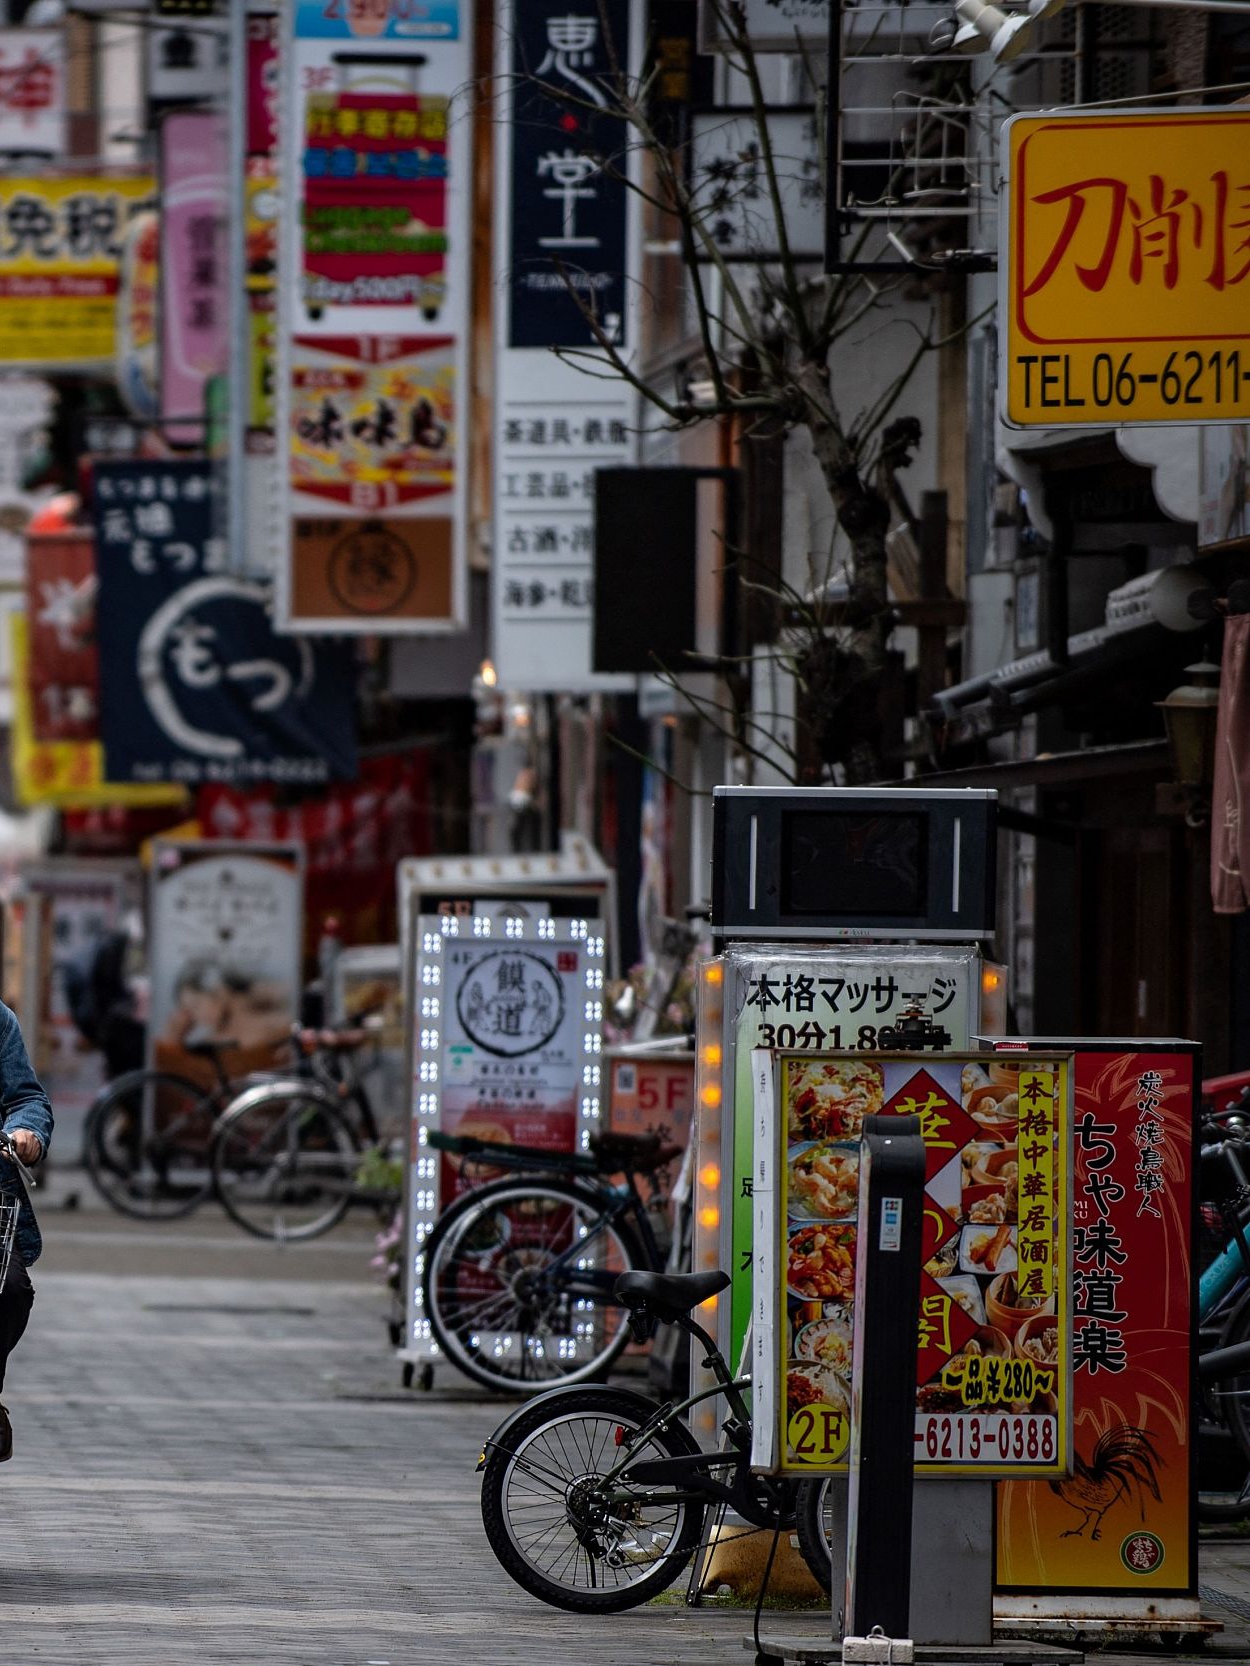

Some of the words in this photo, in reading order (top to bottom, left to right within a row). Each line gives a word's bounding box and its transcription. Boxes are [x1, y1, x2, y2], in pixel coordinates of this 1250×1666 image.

[1023, 170, 1250, 298] 刀削
[1017, 354, 1086, 408] TEL
[504, 580, 595, 608] 海参・乾
[746, 973, 957, 1014] 本格マッサージ
[638, 1076, 687, 1111] 5F
[1134, 1070, 1165, 1218] 炭火焼鳥職人
[1018, 1076, 1054, 1296] 本格中華居酒屋
[795, 1410, 844, 1455] 2F
